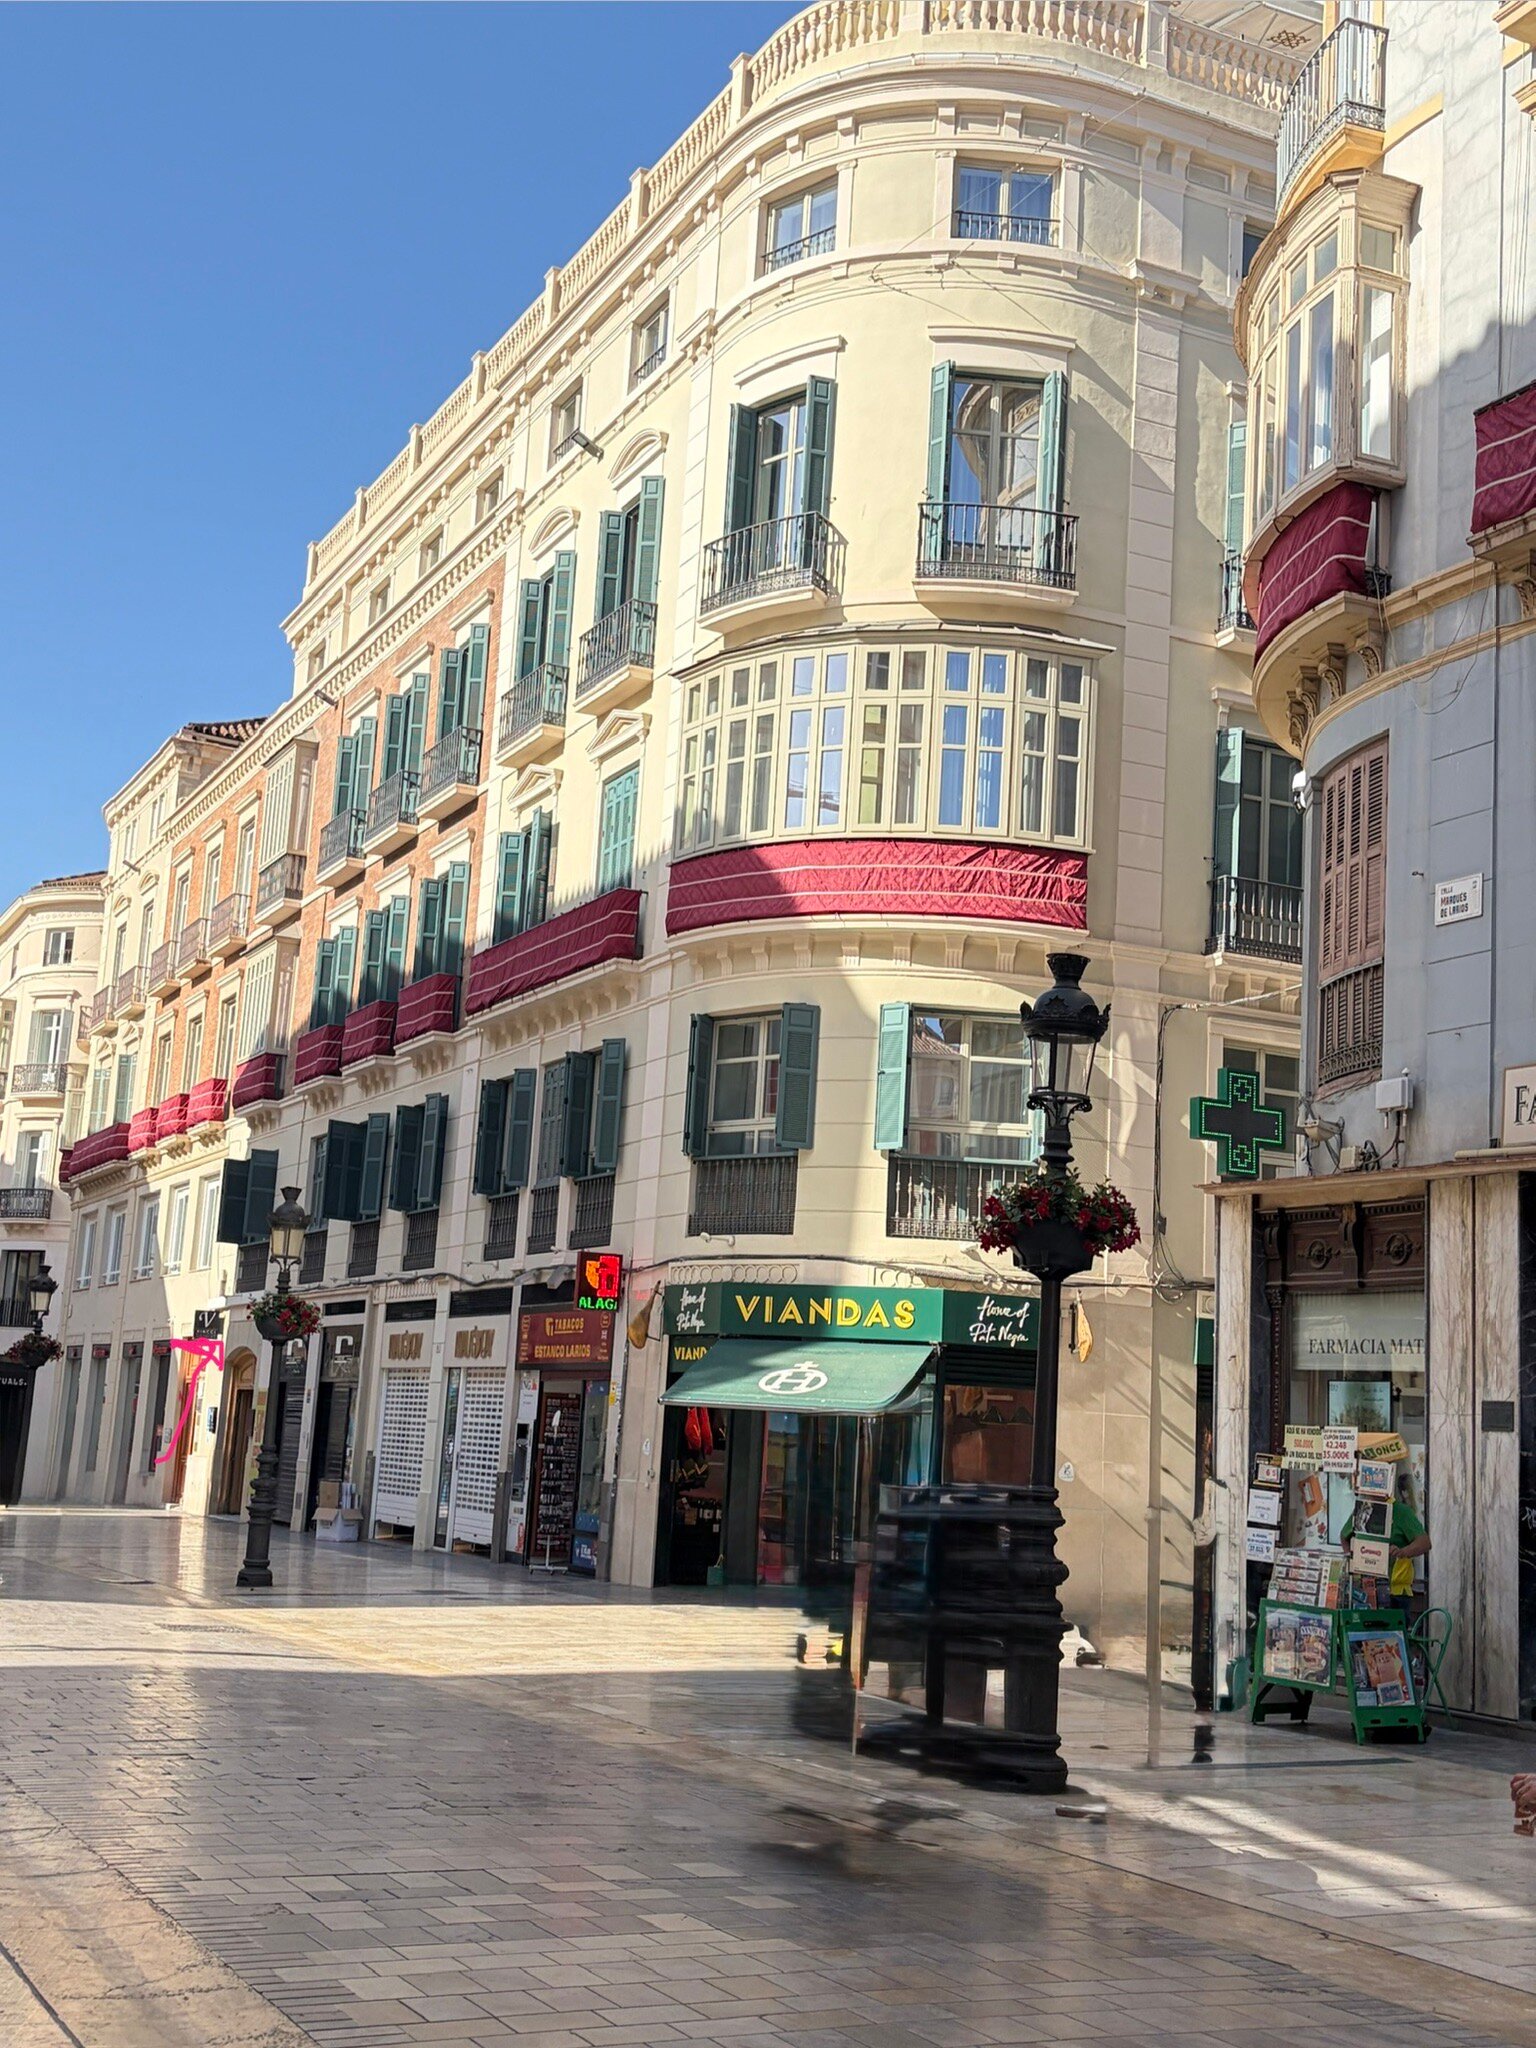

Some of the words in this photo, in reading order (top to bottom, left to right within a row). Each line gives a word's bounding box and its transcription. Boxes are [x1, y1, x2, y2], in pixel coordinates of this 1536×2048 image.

[1440, 908, 1447, 918] DE
[735, 1295, 915, 1329] VIANDAS
[977, 1296, 1014, 1321] House
[1015, 1302, 1030, 1329] of
[555, 1318, 584, 1330] TABACOS
[969, 1323, 996, 1343] Pata
[997, 1321, 1029, 1347] Negra
[535, 1346, 565, 1358] ESTANCO
[566, 1345, 591, 1357] LARIOS
[674, 1347, 707, 1360] VIAND
[1309, 1339, 1386, 1354] FARMACIA
[1390, 1339, 1425, 1354] MAT
[1323, 1451, 1350, 1459] 35.000€
[1375, 1441, 1402, 1456] ONCE
